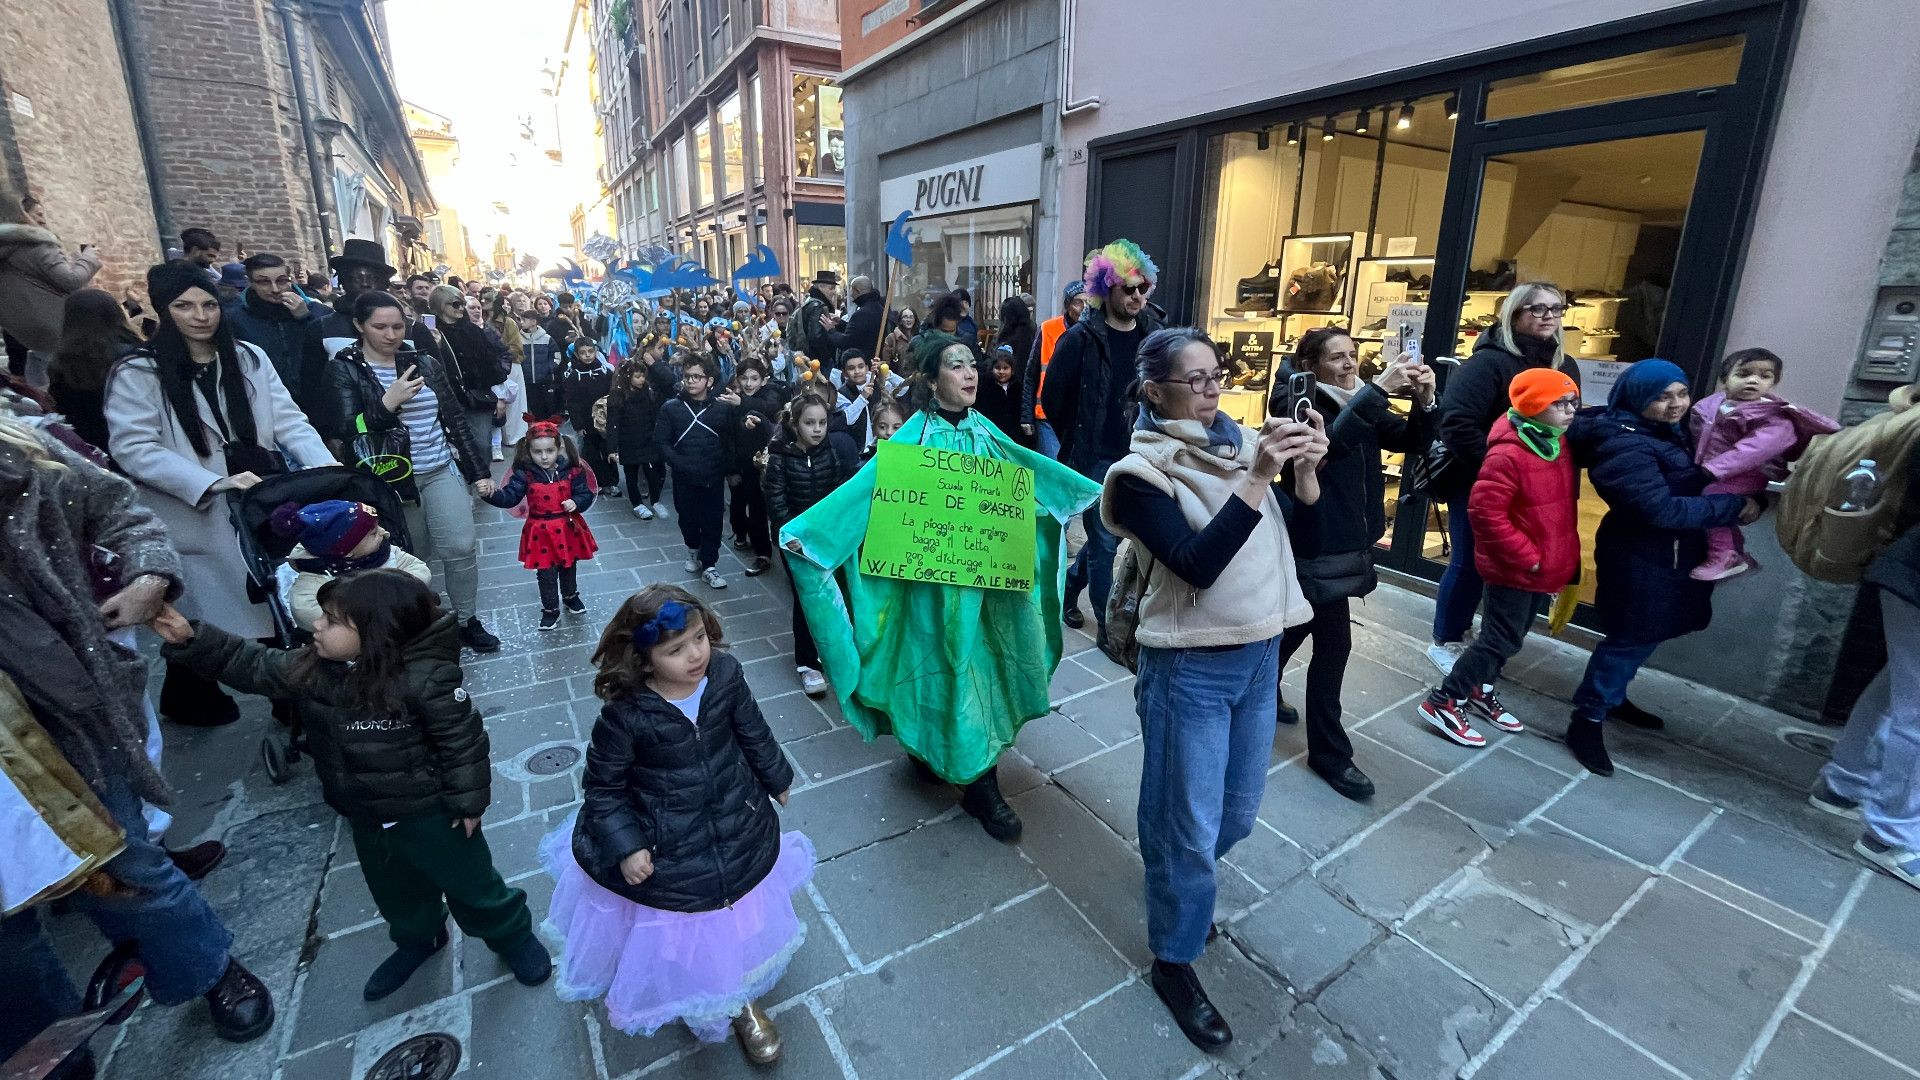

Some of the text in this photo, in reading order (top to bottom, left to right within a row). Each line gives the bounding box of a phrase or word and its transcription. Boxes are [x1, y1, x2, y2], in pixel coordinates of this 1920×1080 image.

[1072, 149, 1082, 161] 38
[914, 164, 984, 211] PUGNI
[1391, 309, 1422, 317] IGI&CO
[920, 449, 1004, 481] SECONDA
[937, 478, 963, 491] Scuola
[872, 487, 929, 506] ALCIDE
[945, 494, 966, 510] DE
[902, 512, 1008, 543] La pioggia che amiamo
[912, 530, 940, 554] bagna
[947, 535, 953, 549] il
[866, 558, 887, 574] W
[890, 562, 908, 579] LE
[913, 567, 958, 583] GOCCE
[989, 575, 1001, 588] LE
[1004, 577, 1030, 590] BOMBE
[905, 551, 924, 567] non
[935, 551, 983, 574] distrugge
[990, 555, 998, 569] la
